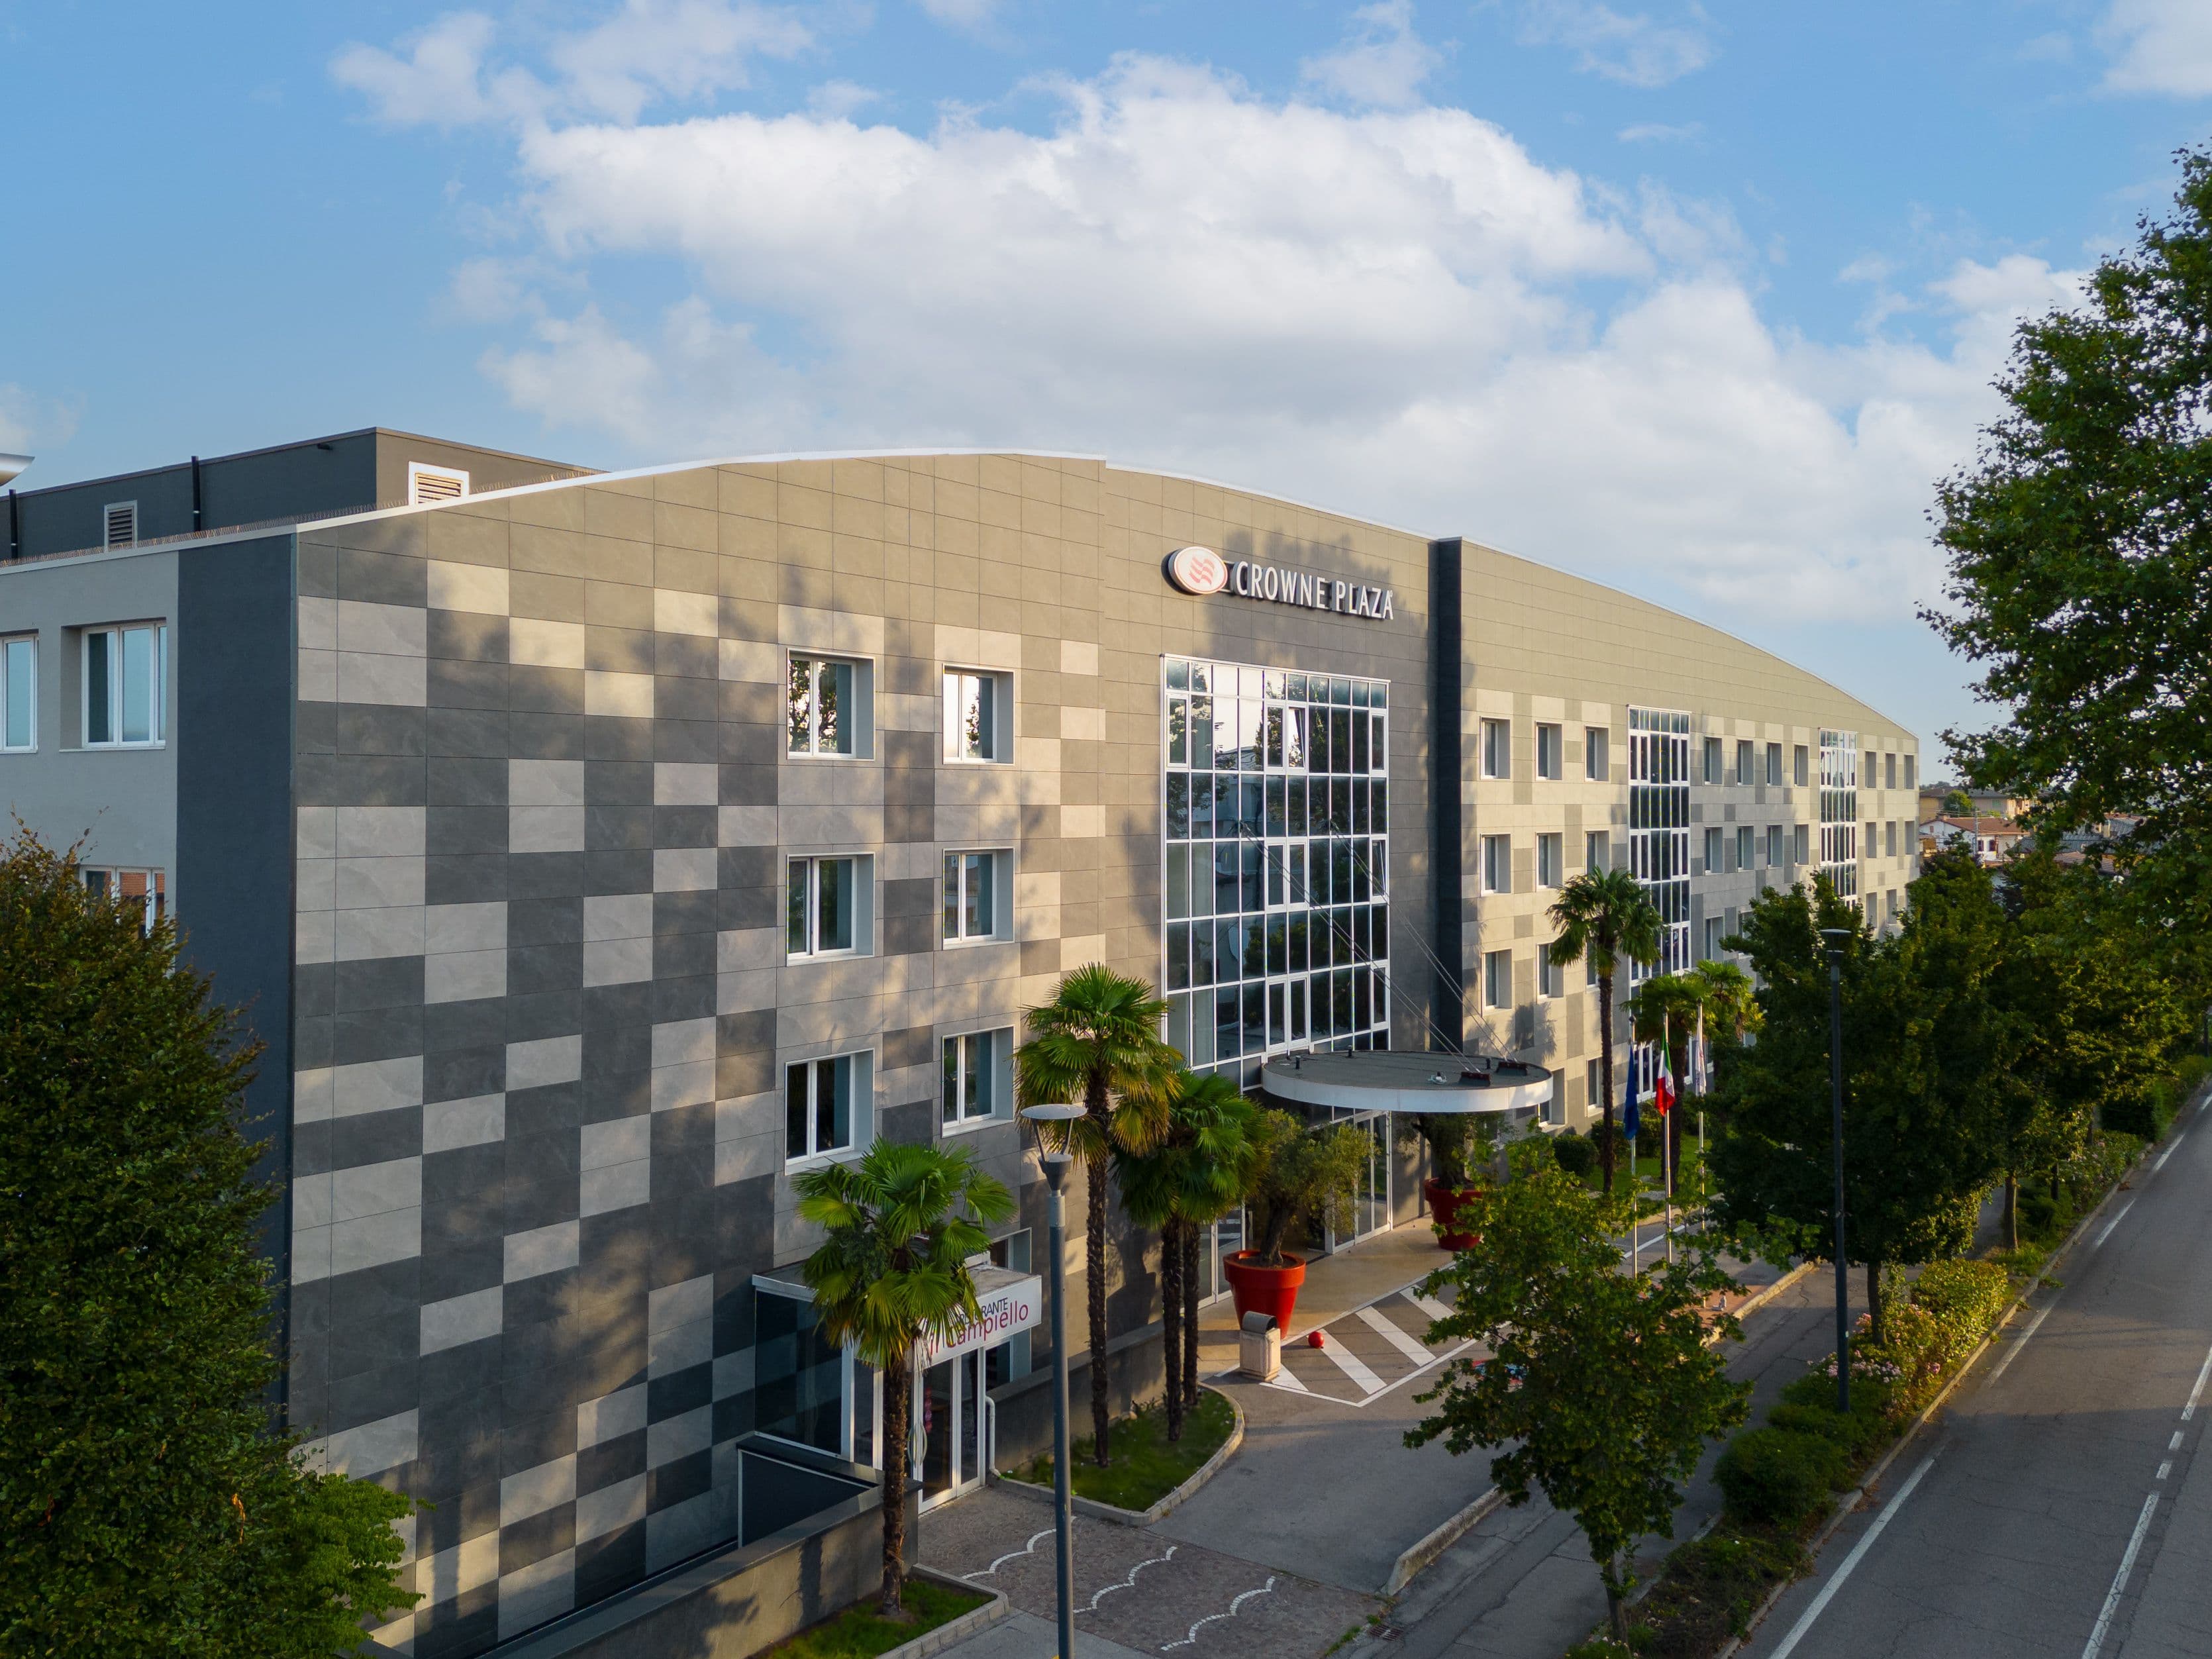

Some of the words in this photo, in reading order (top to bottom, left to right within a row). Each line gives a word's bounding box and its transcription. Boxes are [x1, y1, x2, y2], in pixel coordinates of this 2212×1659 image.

[1235, 561, 1326, 609] CROWNE
[1335, 580, 1394, 620] PLAZA
[959, 1297, 1008, 1326] RIRANTE
